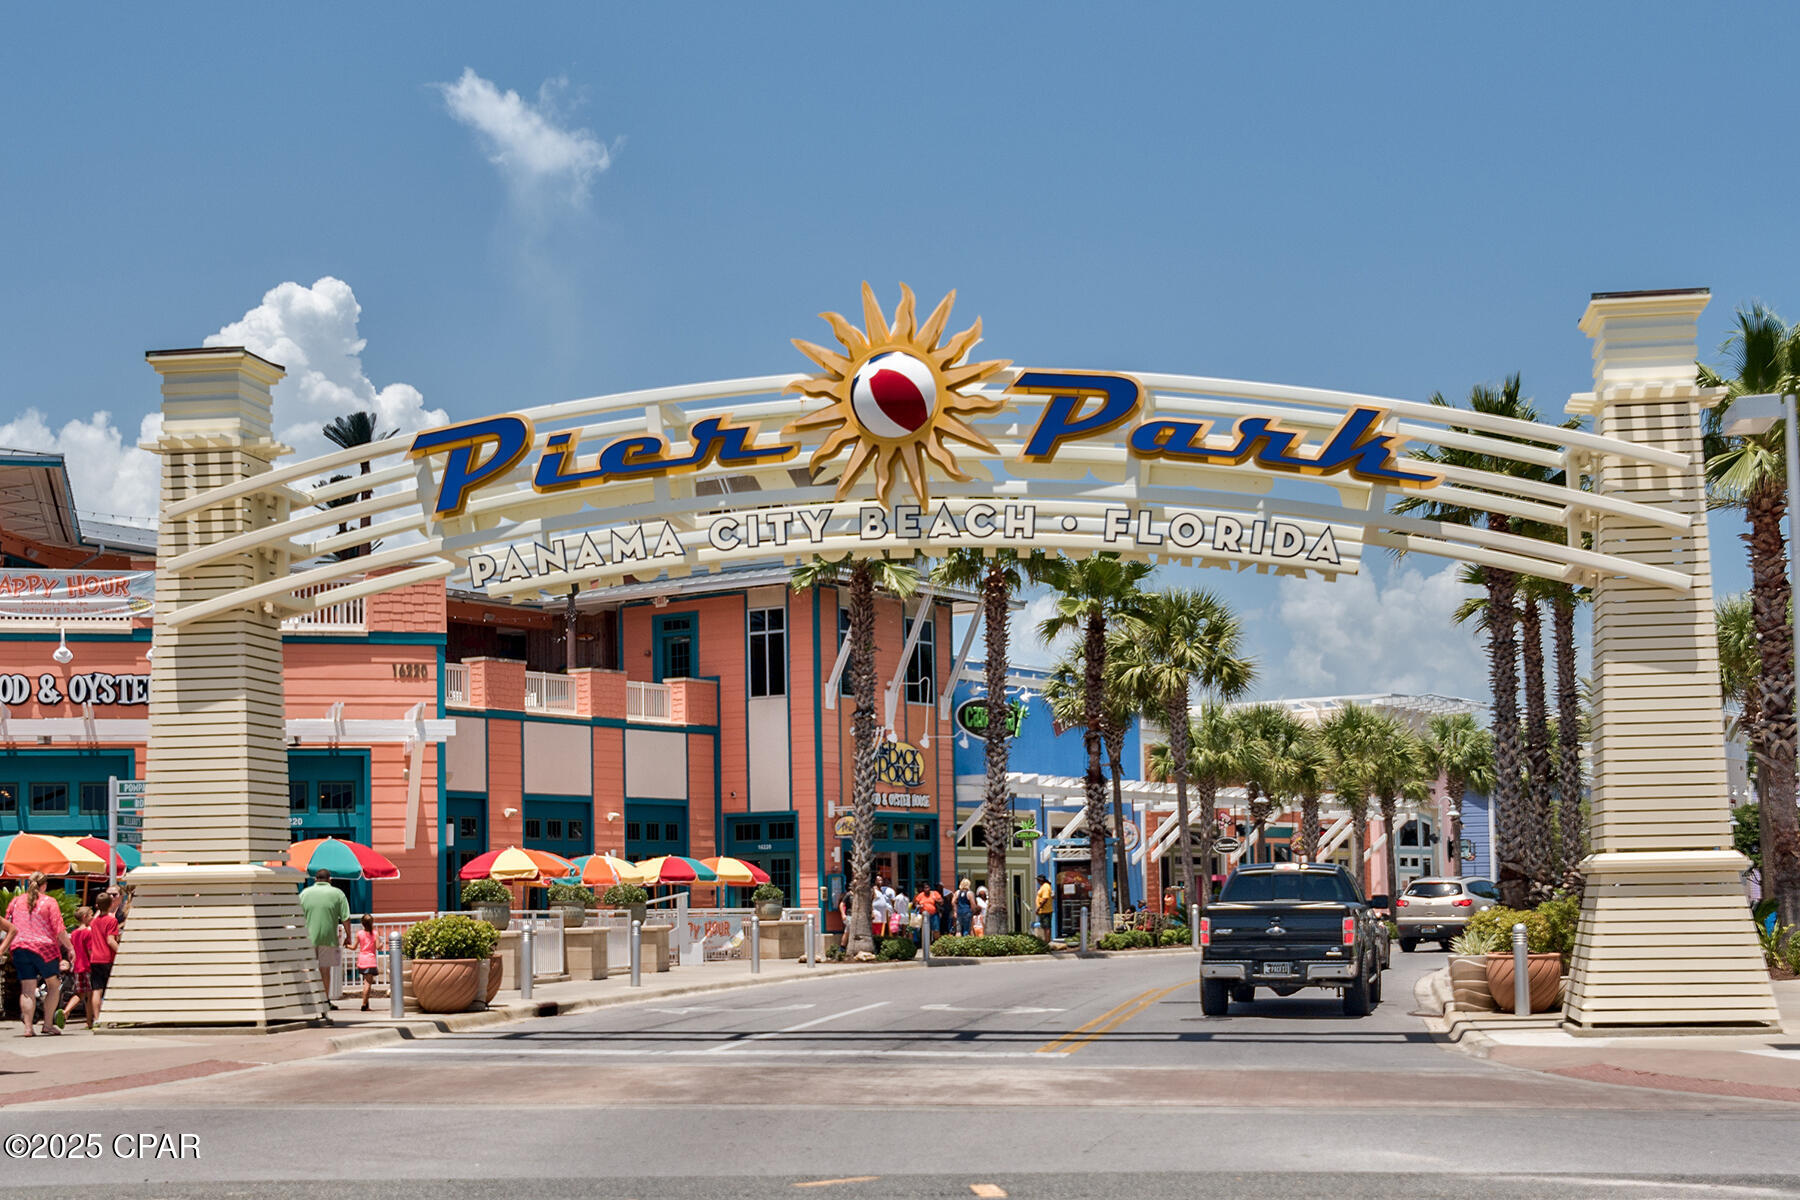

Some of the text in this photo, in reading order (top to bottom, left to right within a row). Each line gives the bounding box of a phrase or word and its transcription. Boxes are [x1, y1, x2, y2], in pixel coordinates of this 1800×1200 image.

[405, 368, 1445, 521] Pier Park
[468, 501, 1342, 588] PANAMA CITY BEACH FLORIDA
[65, 573, 131, 598] HOUR
[392, 663, 428, 682] 16220
[37, 673, 64, 705] &
[68, 672, 150, 704] OYSTE
[876, 756, 925, 787] PORCH
[704, 921, 730, 937] HOUR
